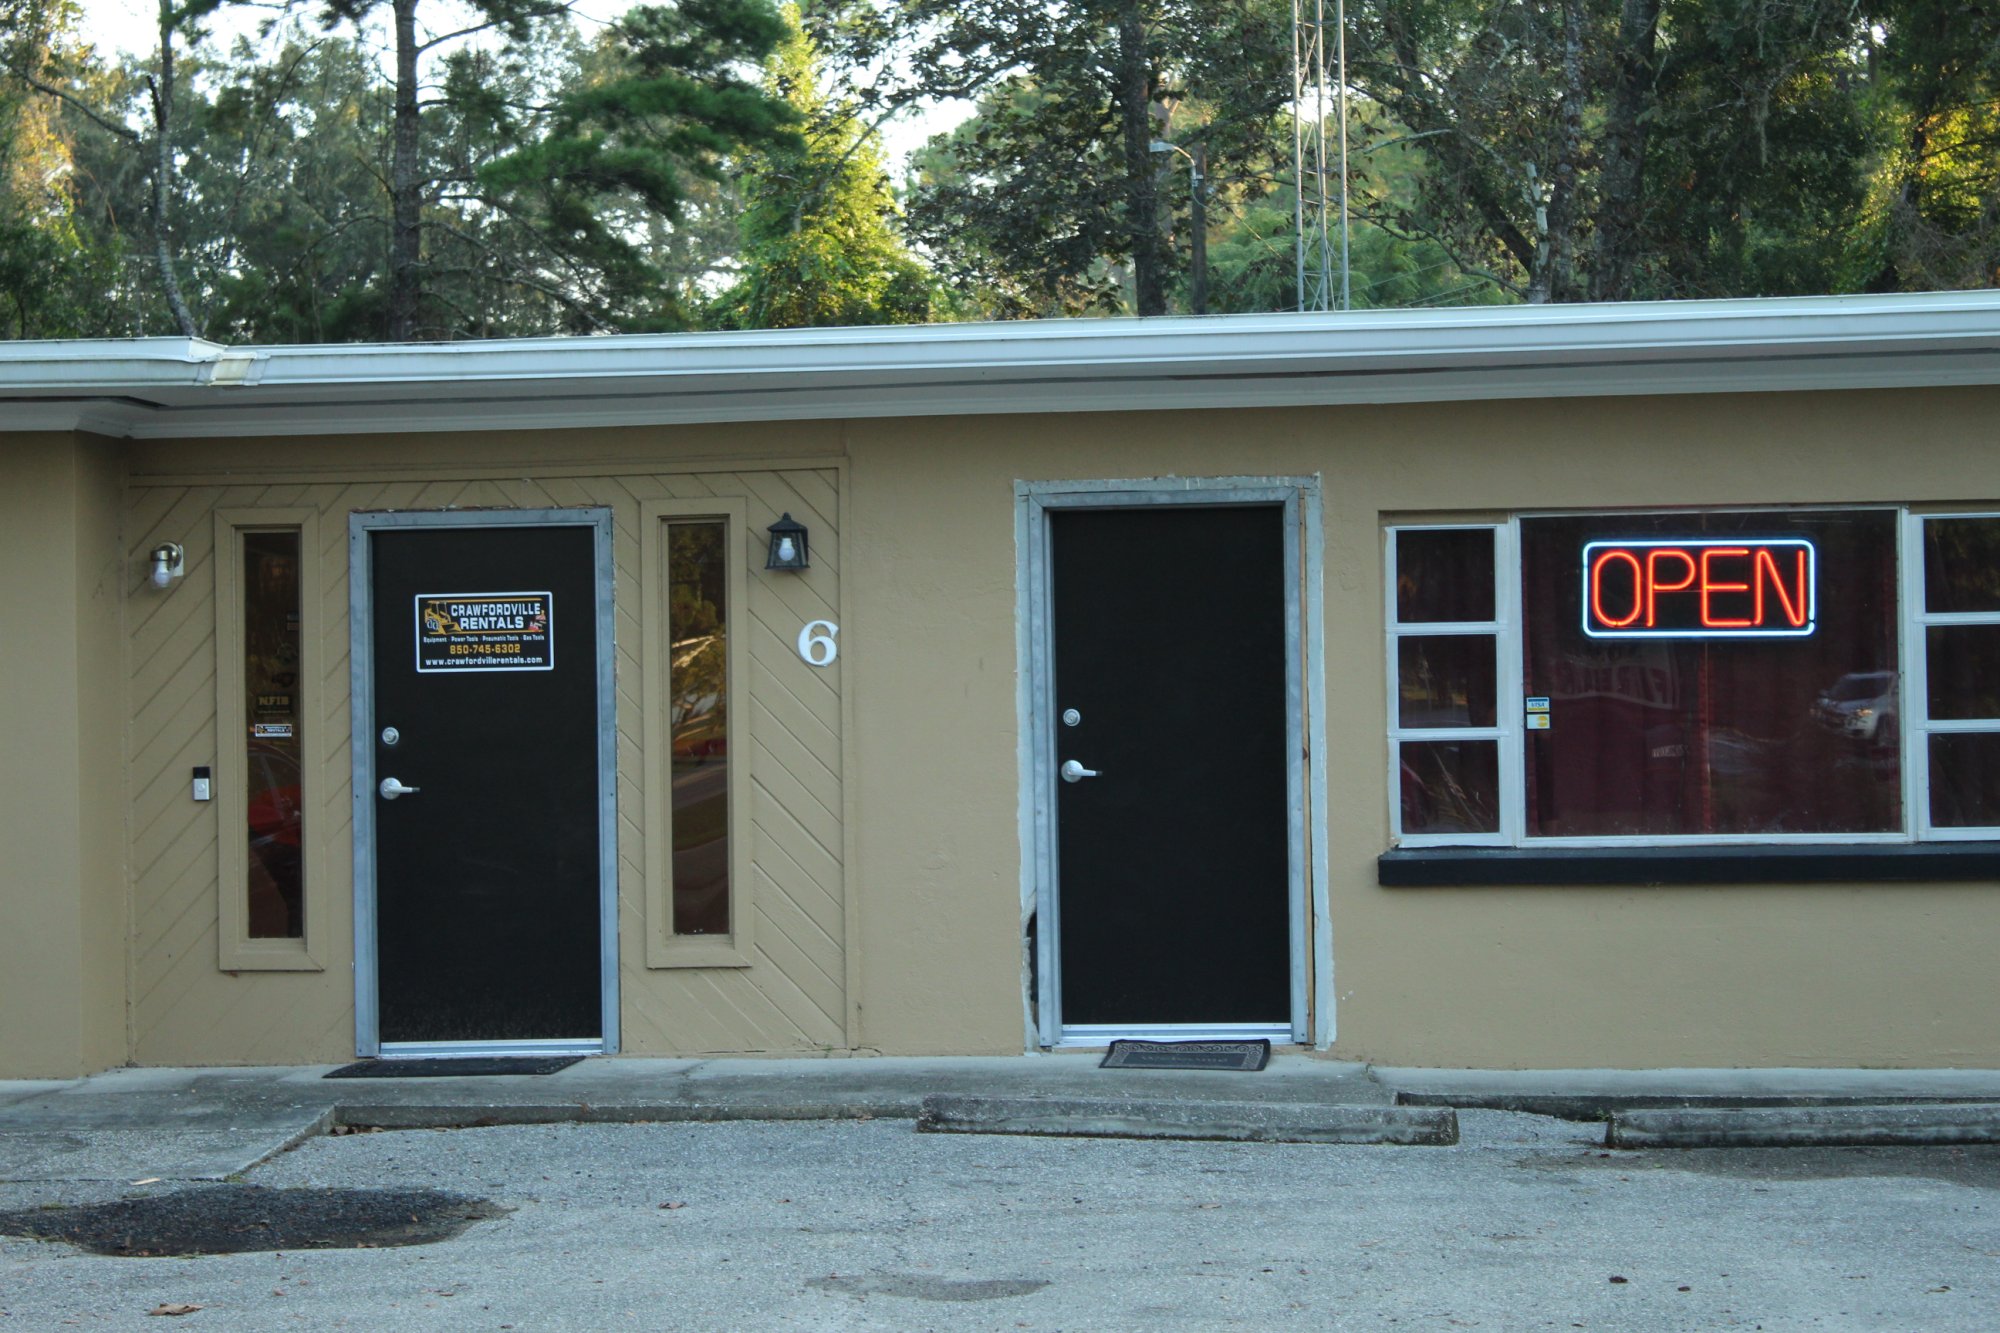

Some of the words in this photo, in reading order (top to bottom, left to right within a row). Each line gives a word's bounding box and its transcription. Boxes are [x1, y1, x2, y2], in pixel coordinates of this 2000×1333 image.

[1592, 548, 1806, 627] OPEN
[451, 603, 541, 617] CRAWFORDVILLE
[460, 616, 524, 629] RENTALS
[791, 613, 839, 667] 6
[426, 656, 542, 666] www.crawfordvillerentals.com
